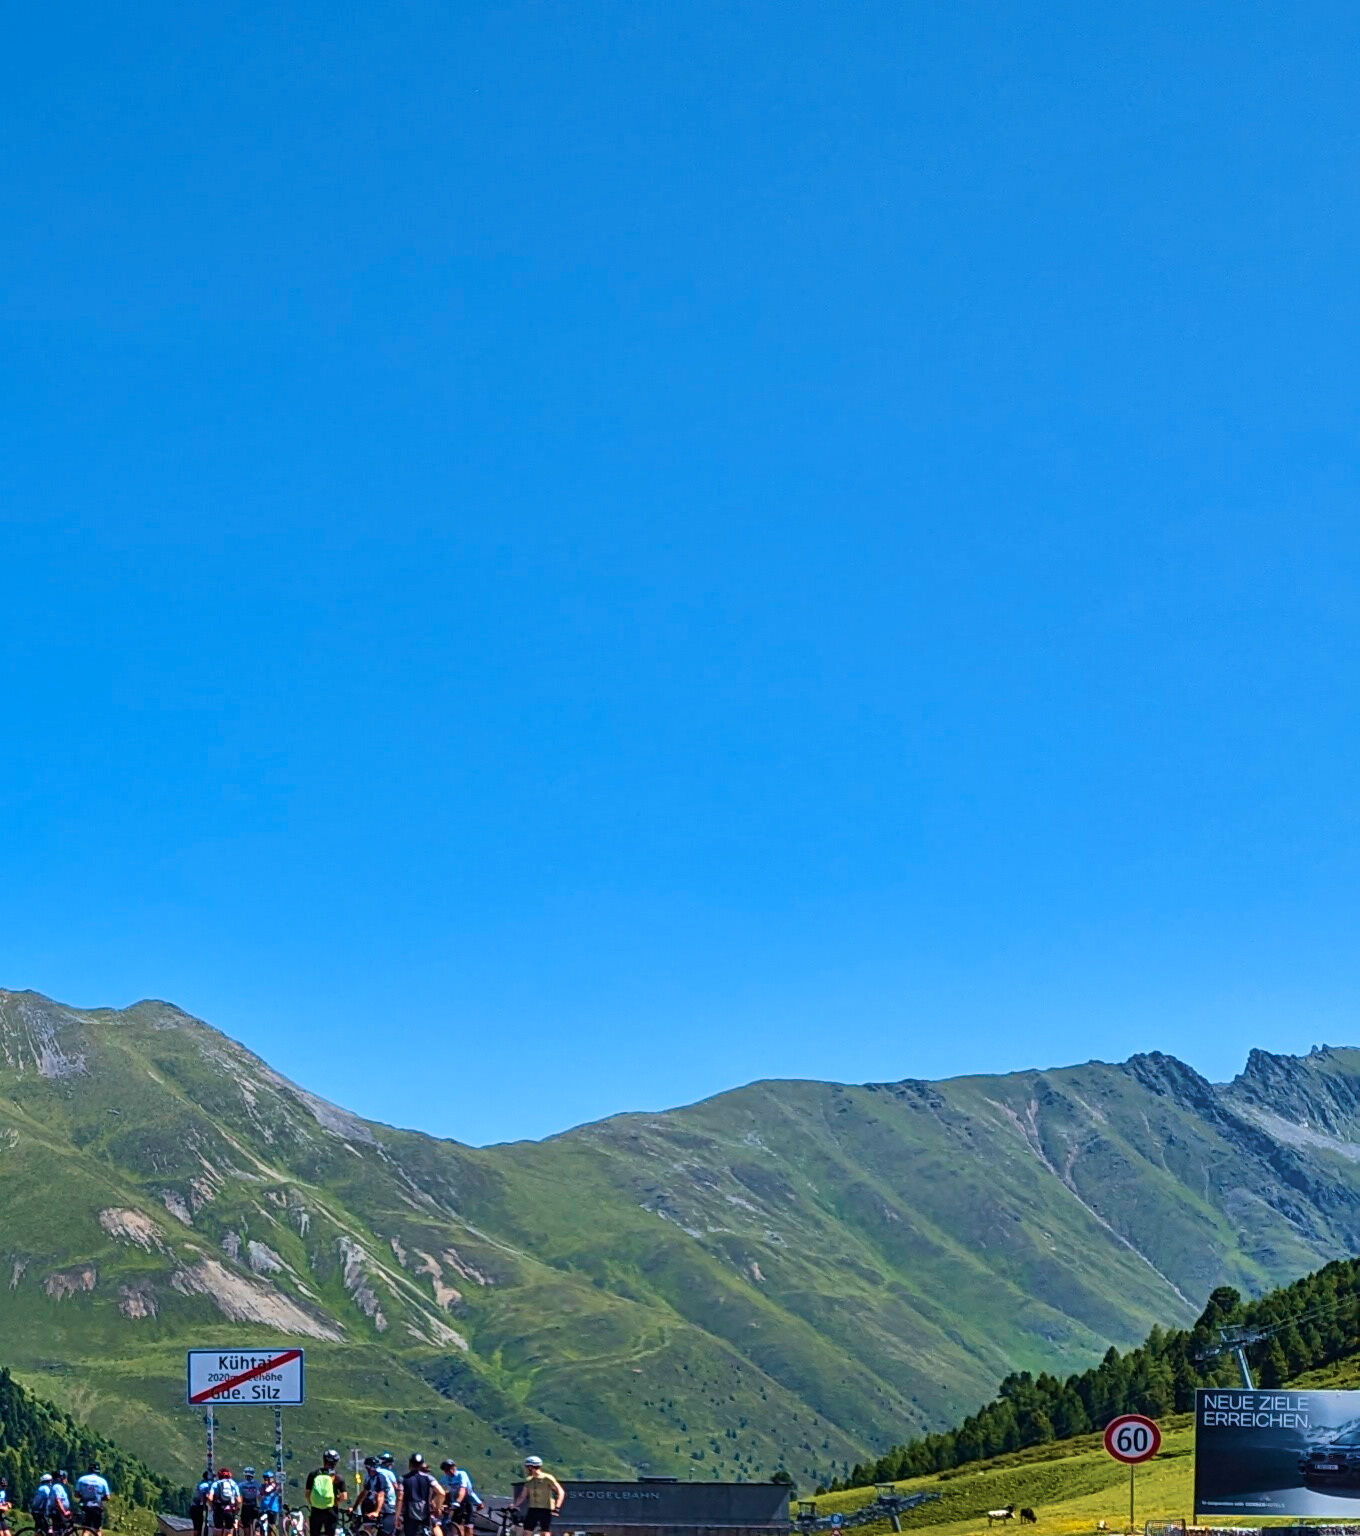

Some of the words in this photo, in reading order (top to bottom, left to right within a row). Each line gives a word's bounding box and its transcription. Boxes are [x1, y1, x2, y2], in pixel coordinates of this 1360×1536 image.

[218, 1354, 272, 1370] Kühtai
[251, 1384, 280, 1400] Silz
[1203, 1394, 1254, 1411] NEUE
[1258, 1395, 1309, 1412] ZIELE
[1203, 1412, 1313, 1429] ERREICHEN.
[1117, 1427, 1149, 1452] 60
[569, 1491, 660, 1500] SKOGELBAHN
